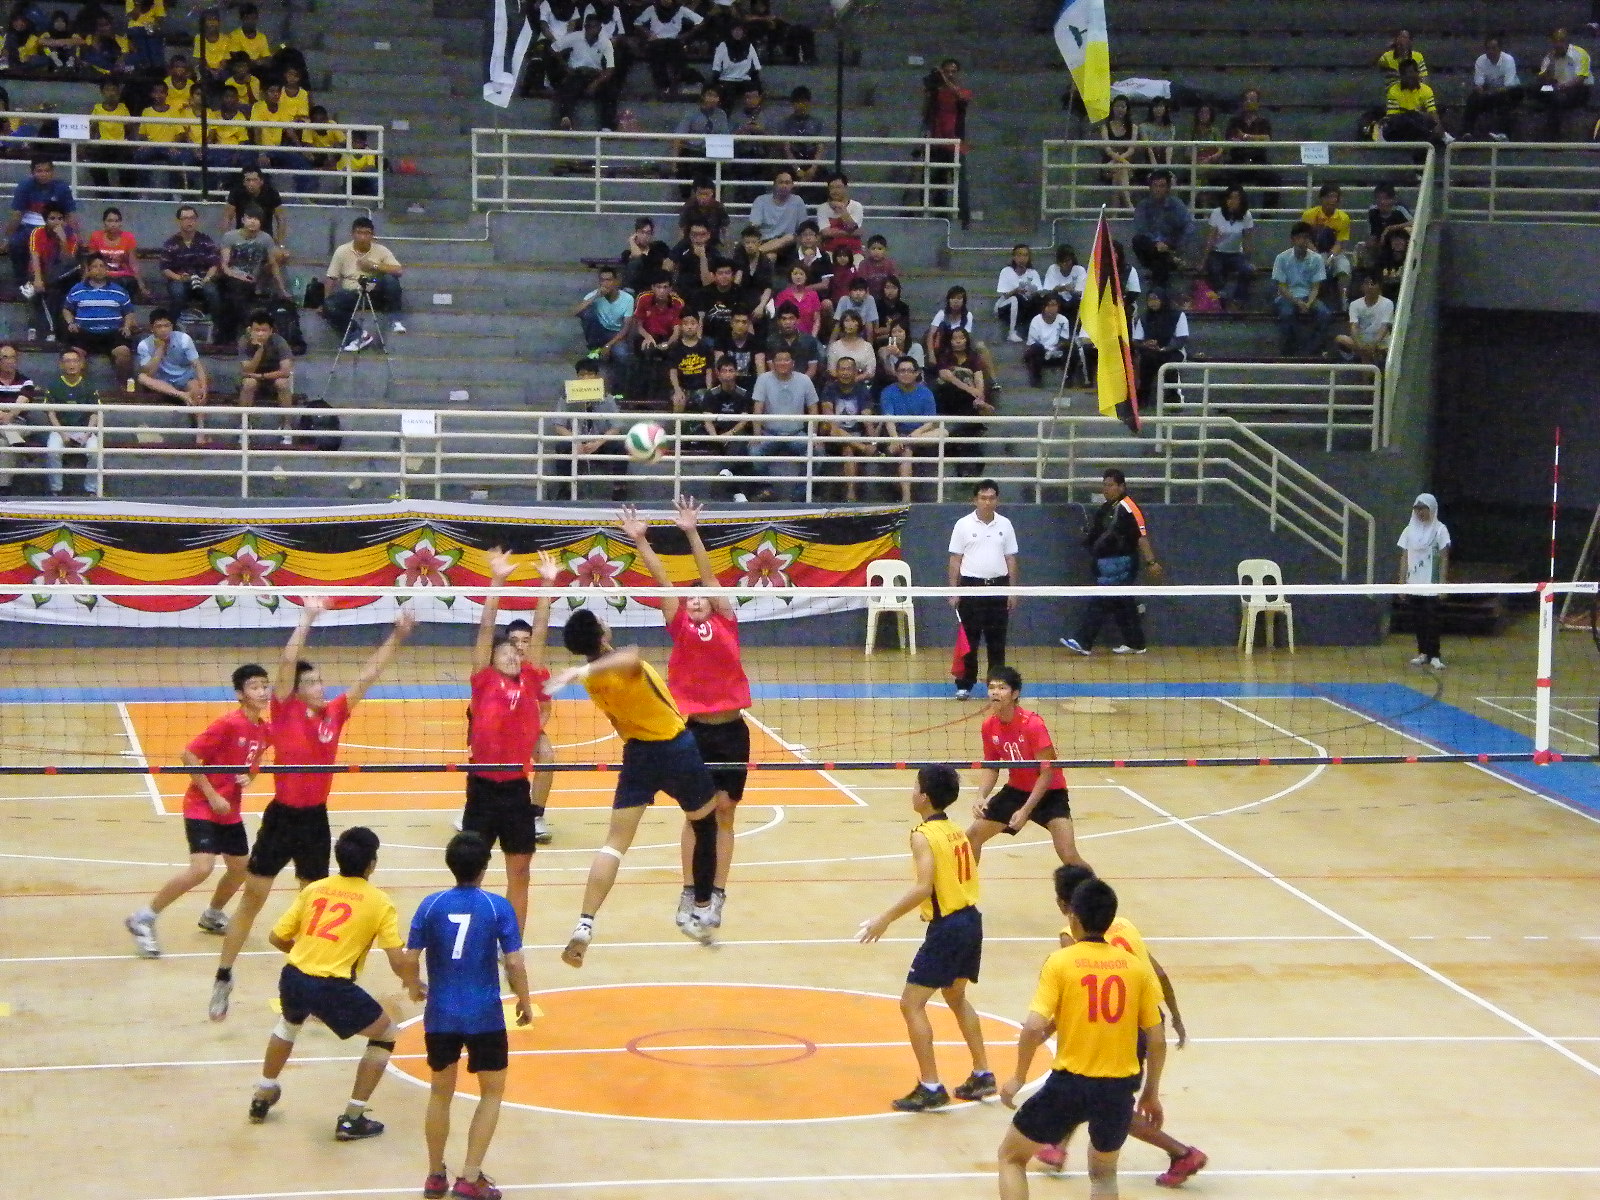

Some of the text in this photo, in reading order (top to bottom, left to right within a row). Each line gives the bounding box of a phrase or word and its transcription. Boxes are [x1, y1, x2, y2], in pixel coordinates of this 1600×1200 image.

[954, 841, 971, 885] 11
[306, 897, 353, 942] 12
[447, 913, 472, 960] 7
[1074, 958, 1129, 970] SELANGOR
[1080, 973, 1127, 1024] 10
